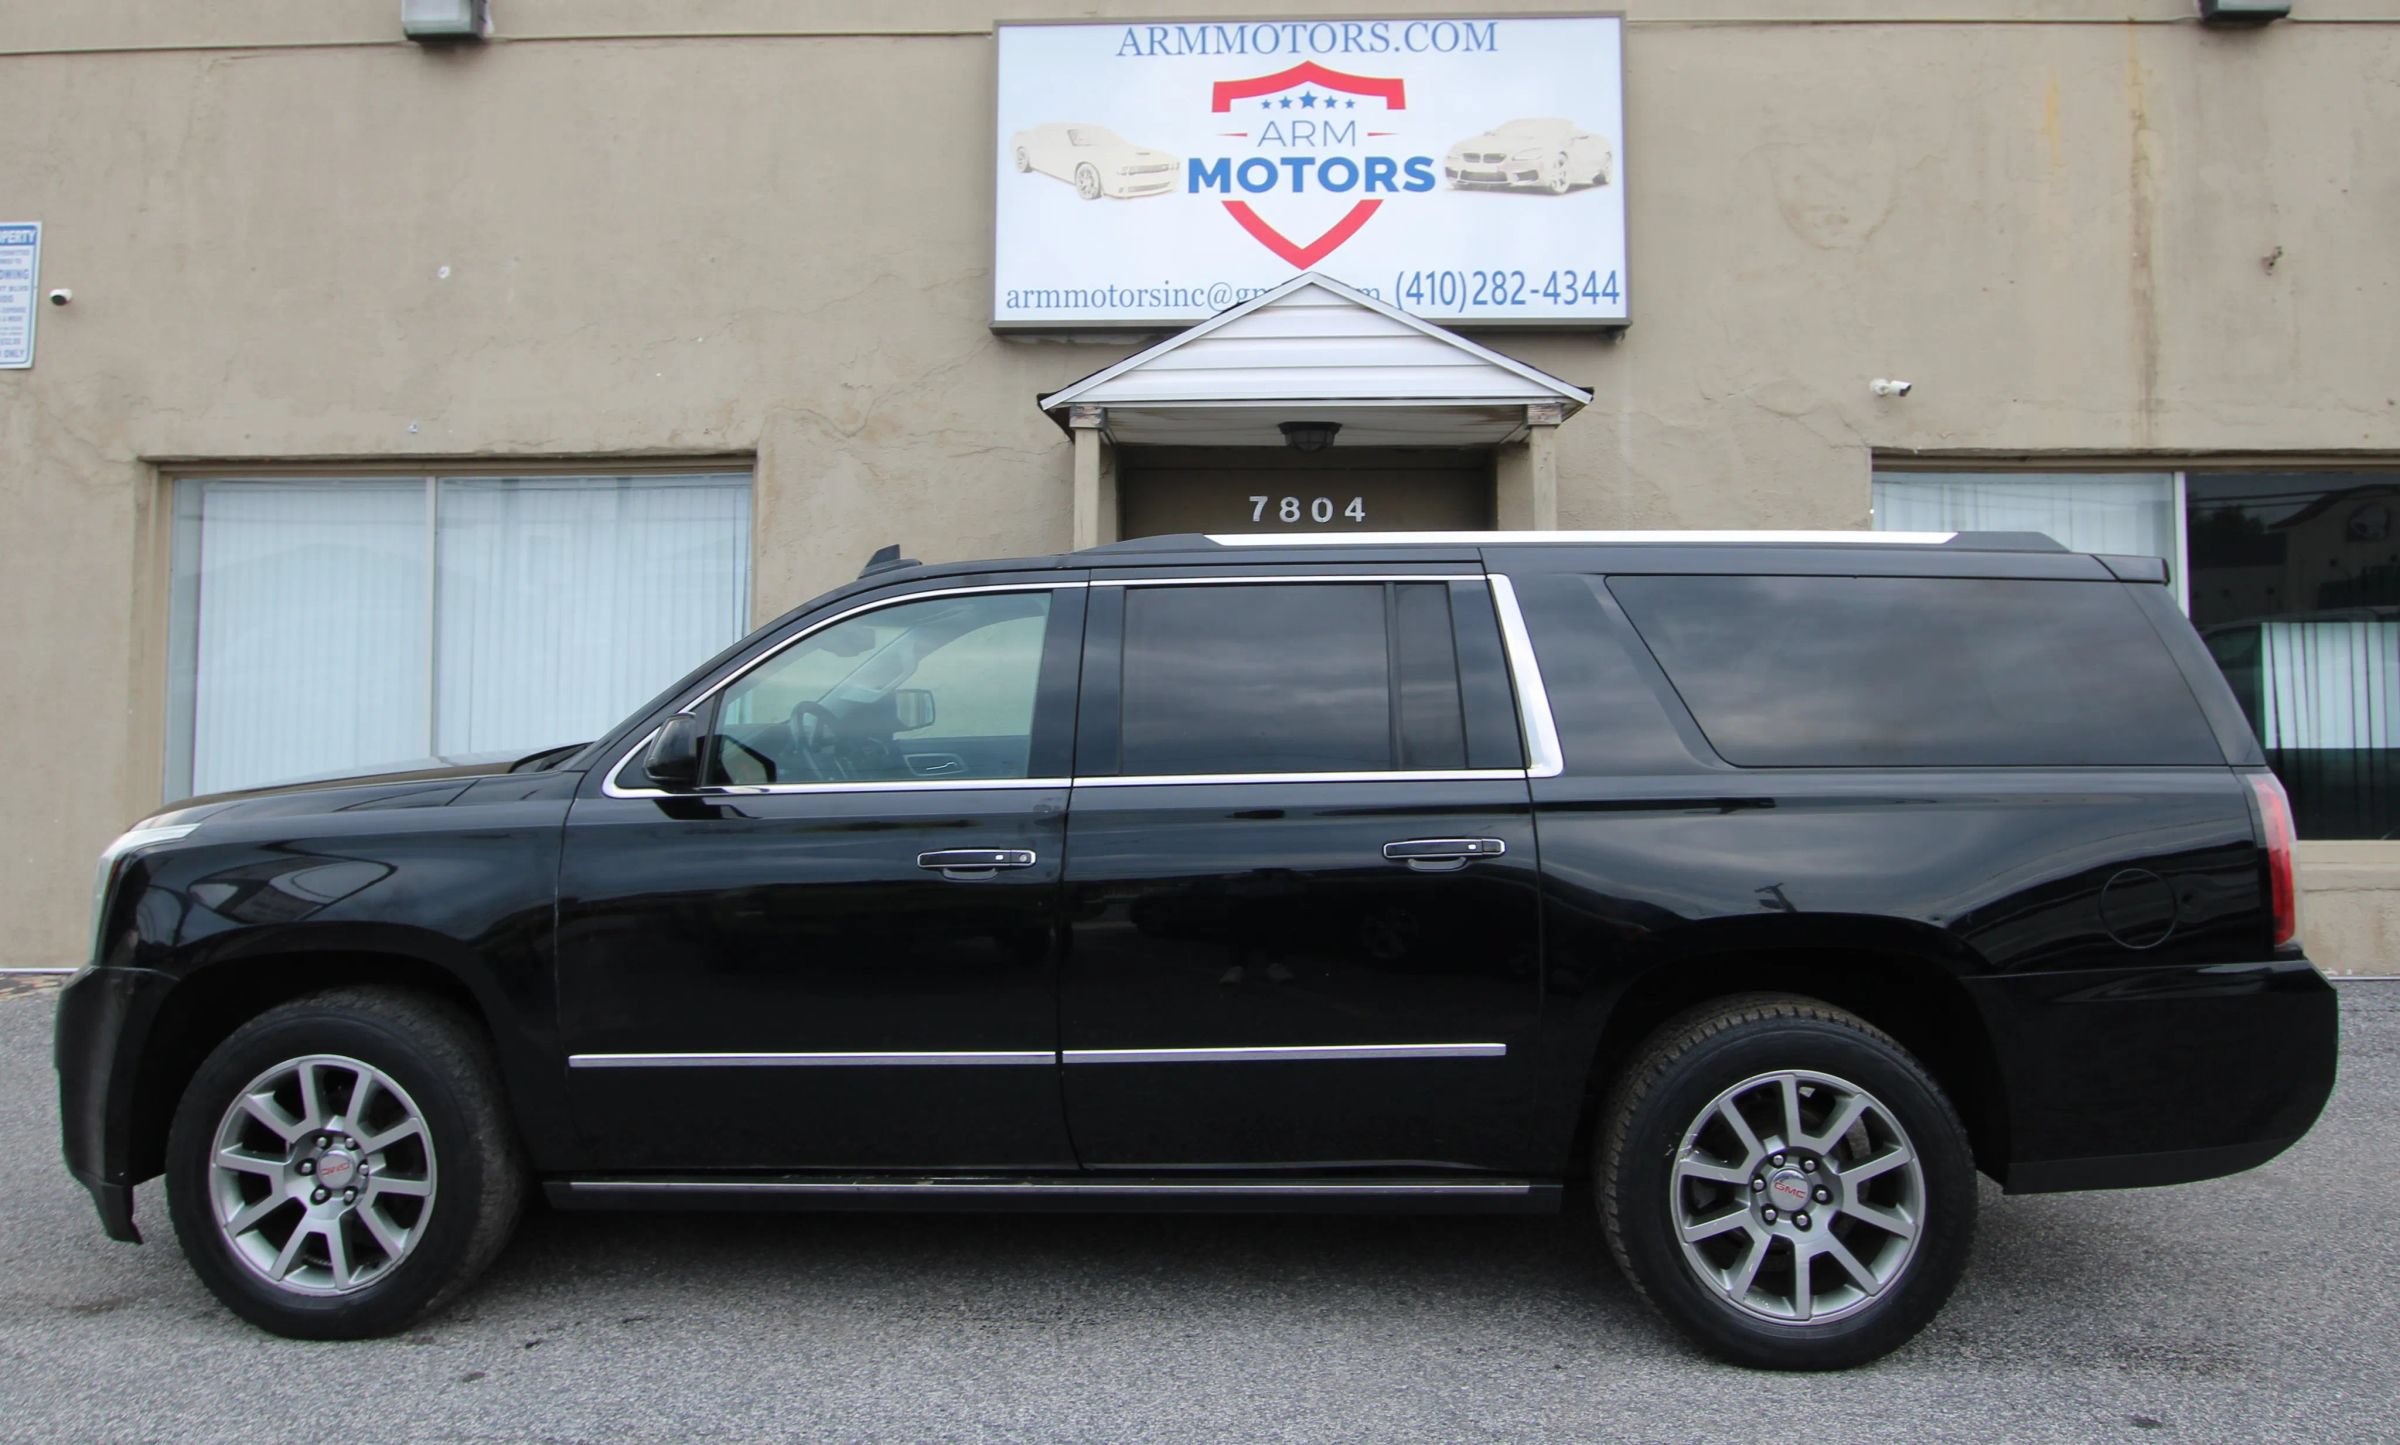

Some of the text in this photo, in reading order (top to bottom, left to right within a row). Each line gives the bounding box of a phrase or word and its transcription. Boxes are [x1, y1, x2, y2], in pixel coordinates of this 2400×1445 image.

[1115, 21, 1499, 57] ARMMOTORS.COM
[1257, 120, 1356, 148] ARM
[1187, 156, 1436, 194] MOTORS
[1395, 270, 1620, 313] (410)282-4344
[1249, 496, 1366, 523] 7804
[1774, 1181, 1806, 1199] GMC
